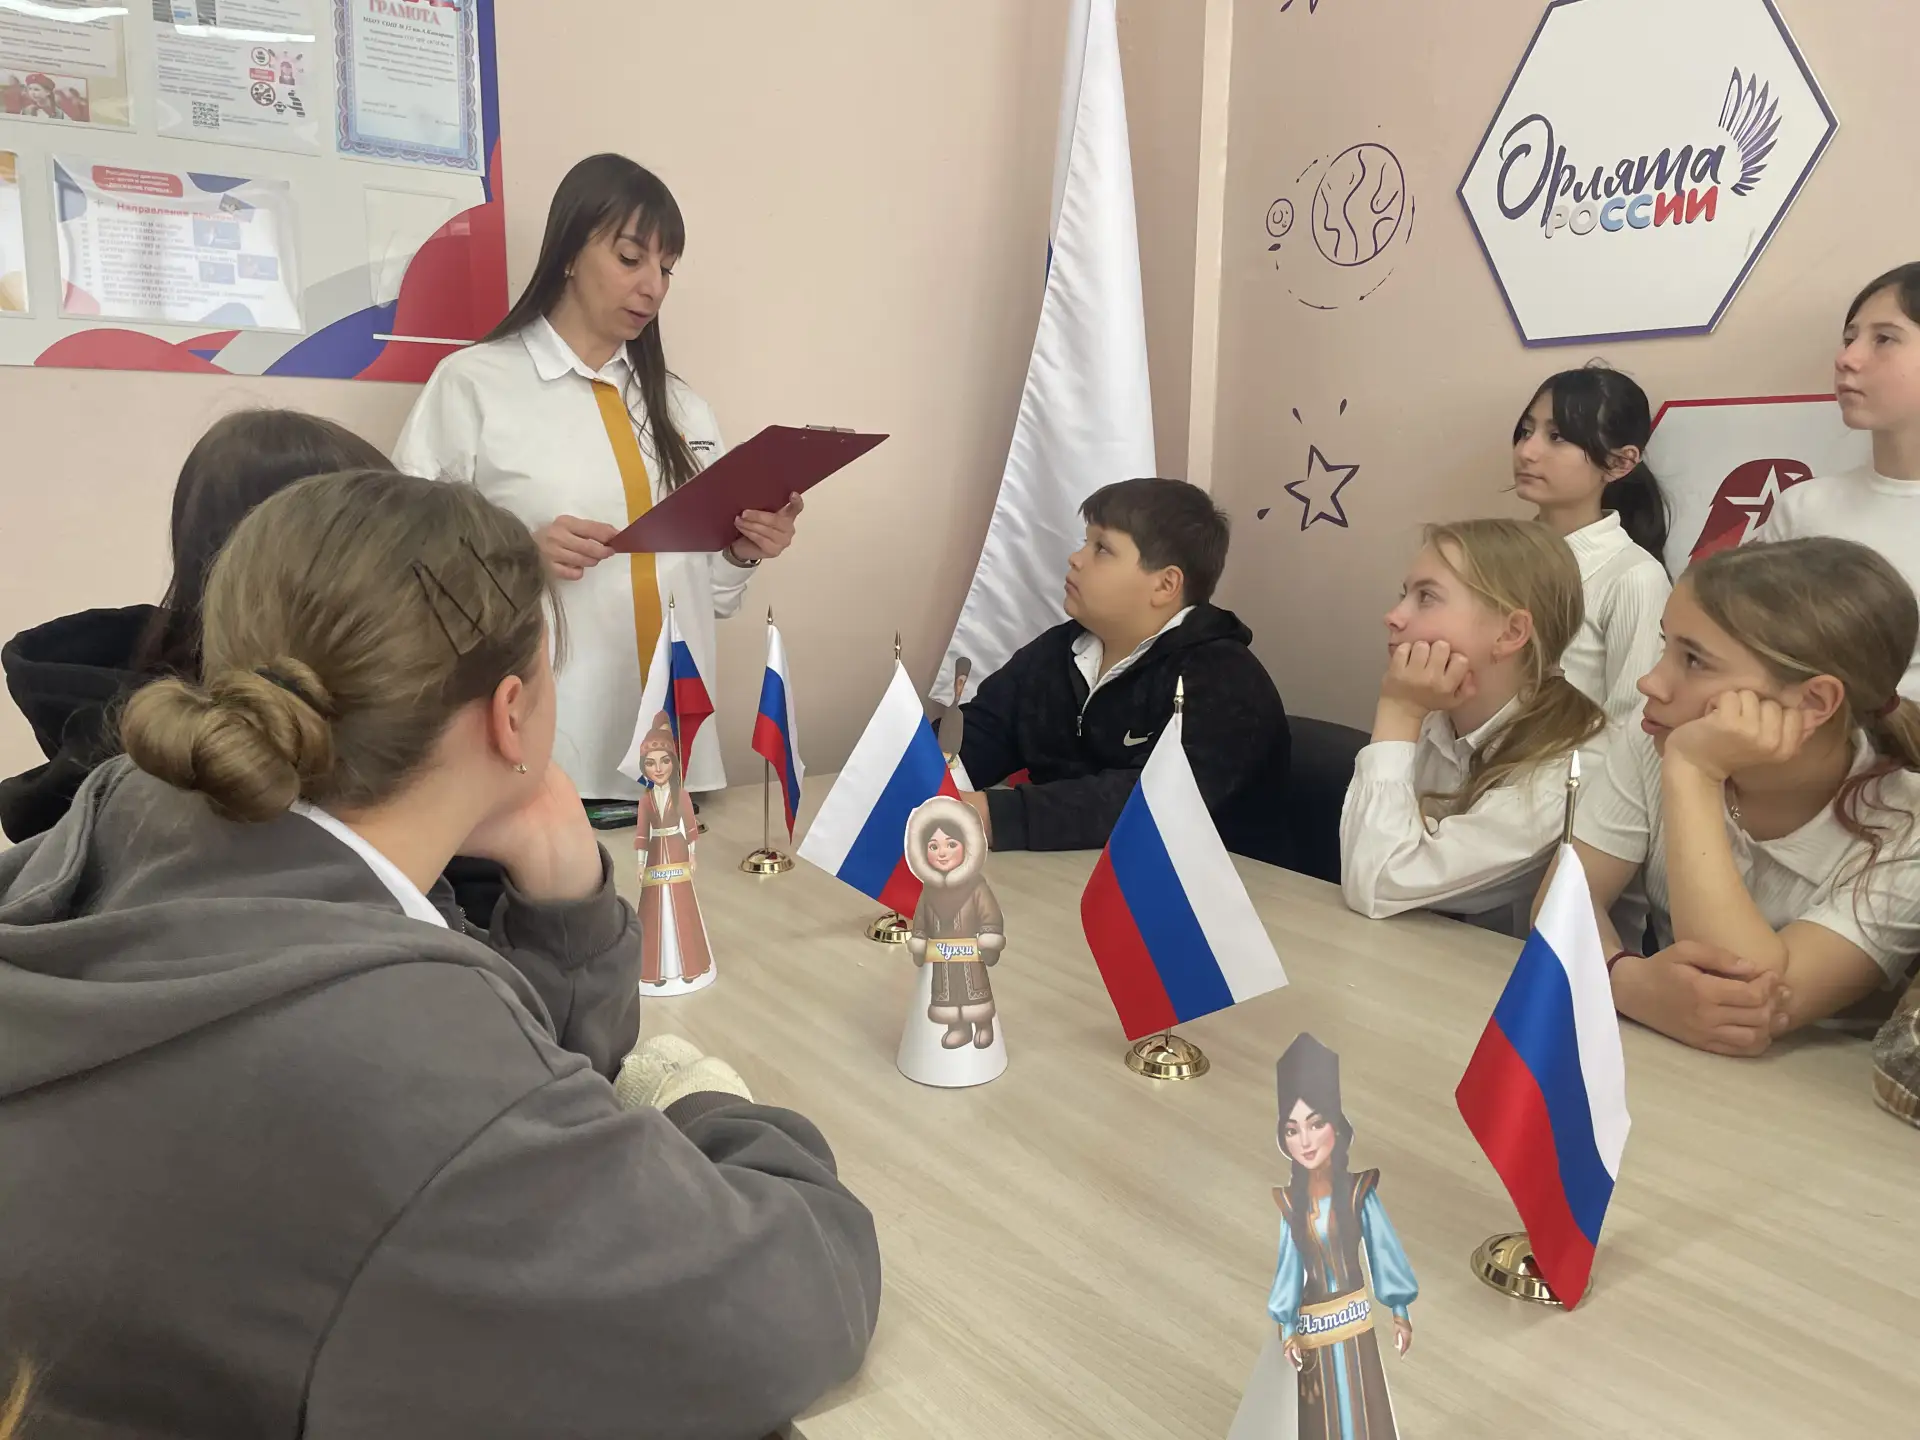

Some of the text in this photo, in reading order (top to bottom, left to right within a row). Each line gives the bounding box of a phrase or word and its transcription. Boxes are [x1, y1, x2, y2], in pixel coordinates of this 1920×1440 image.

[368, 0, 441, 26] ГРАМОТА
[1497, 113, 1726, 228] Орлята
[1544, 185, 1719, 239] РОССИИ
[936, 942, 975, 961] Чукчи
